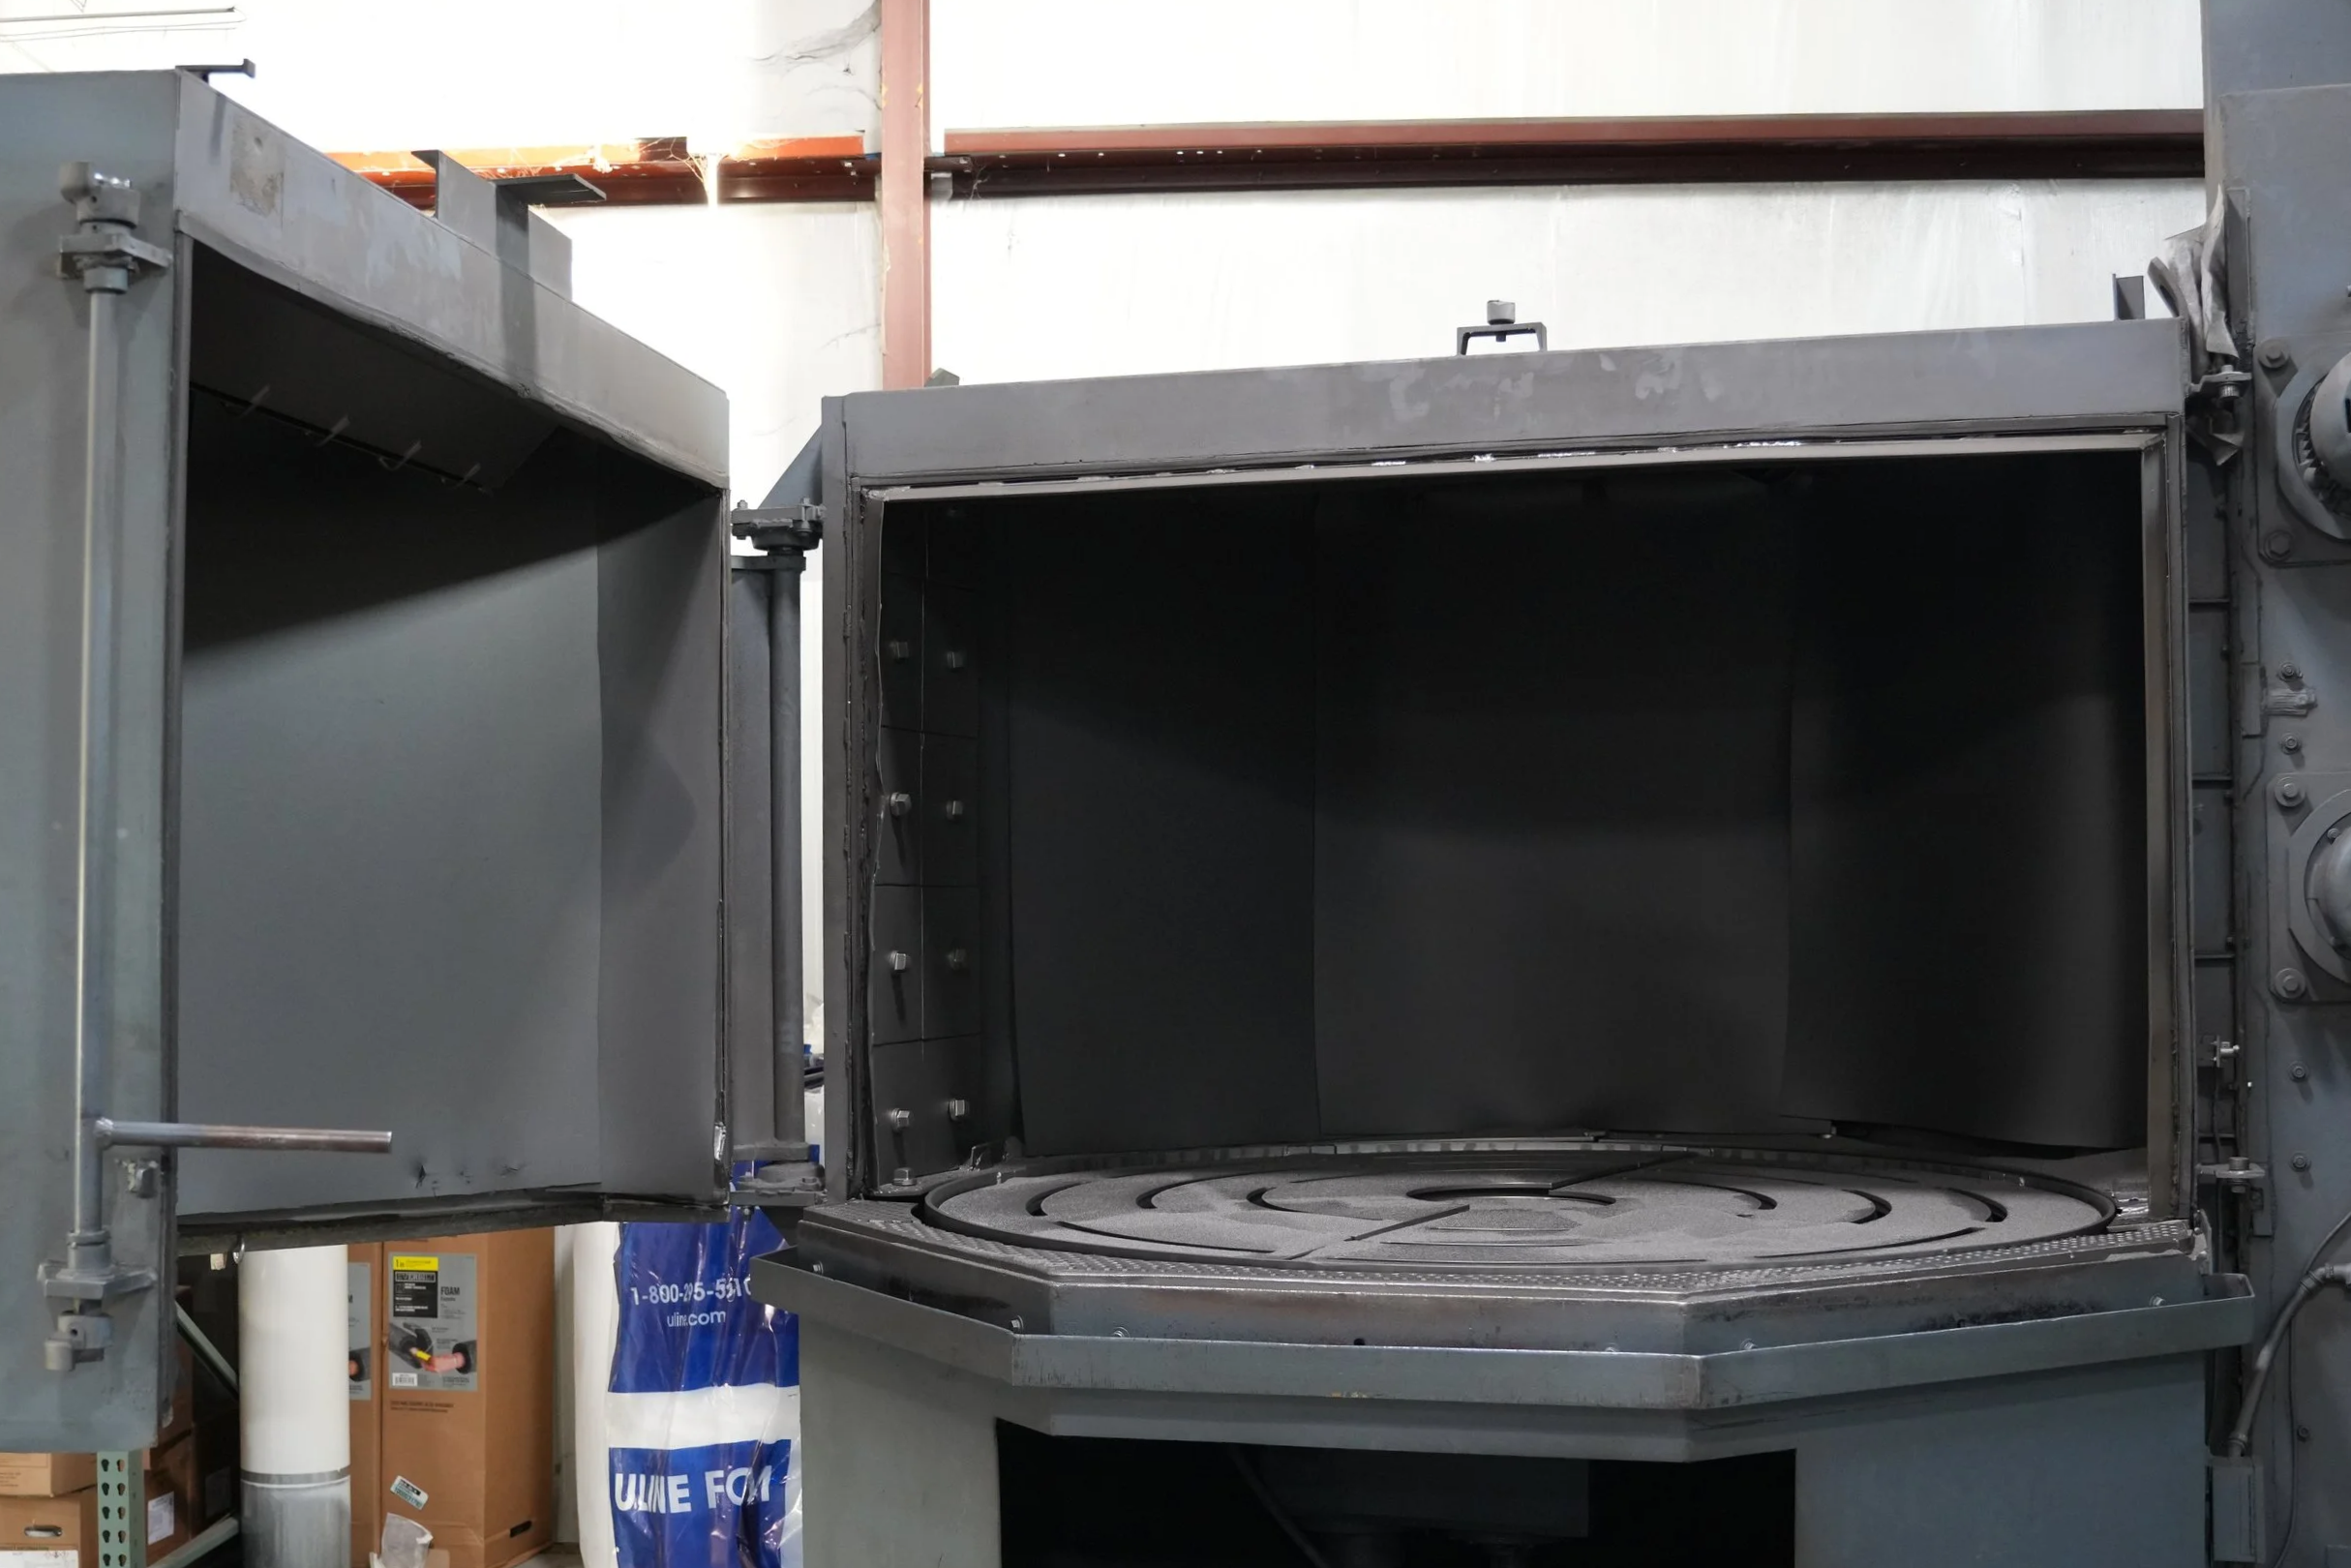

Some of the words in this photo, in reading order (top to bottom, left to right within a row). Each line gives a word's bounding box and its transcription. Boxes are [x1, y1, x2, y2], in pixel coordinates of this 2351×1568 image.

[440, 1286, 460, 1296] FOAM
[667, 1311, 726, 1327] uline.com
[615, 1473, 692, 1514] ULINE
[705, 1464, 772, 1510] FOM
